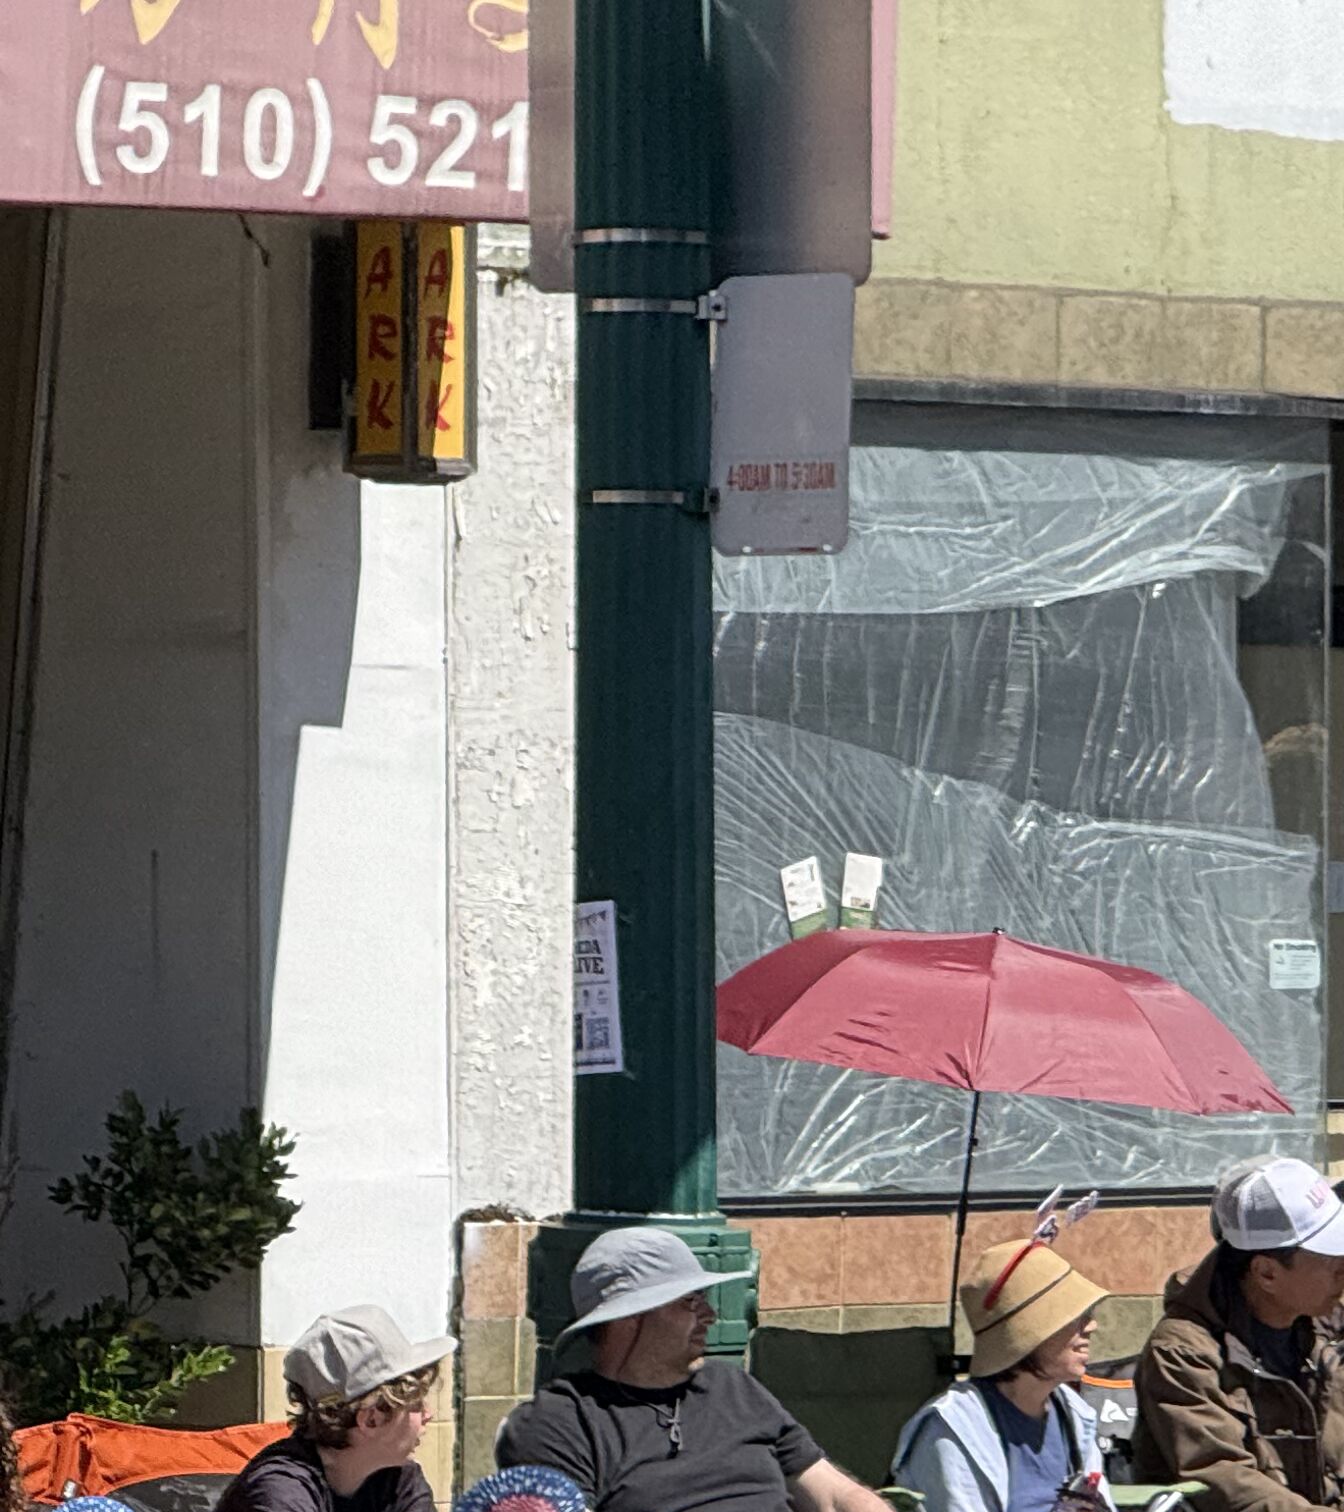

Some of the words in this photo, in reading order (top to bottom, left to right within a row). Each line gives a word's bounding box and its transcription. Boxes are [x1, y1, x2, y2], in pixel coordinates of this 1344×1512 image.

[76, 65, 332, 197] (510)
[364, 246, 397, 430] ARK
[423, 249, 455, 431] ARK
